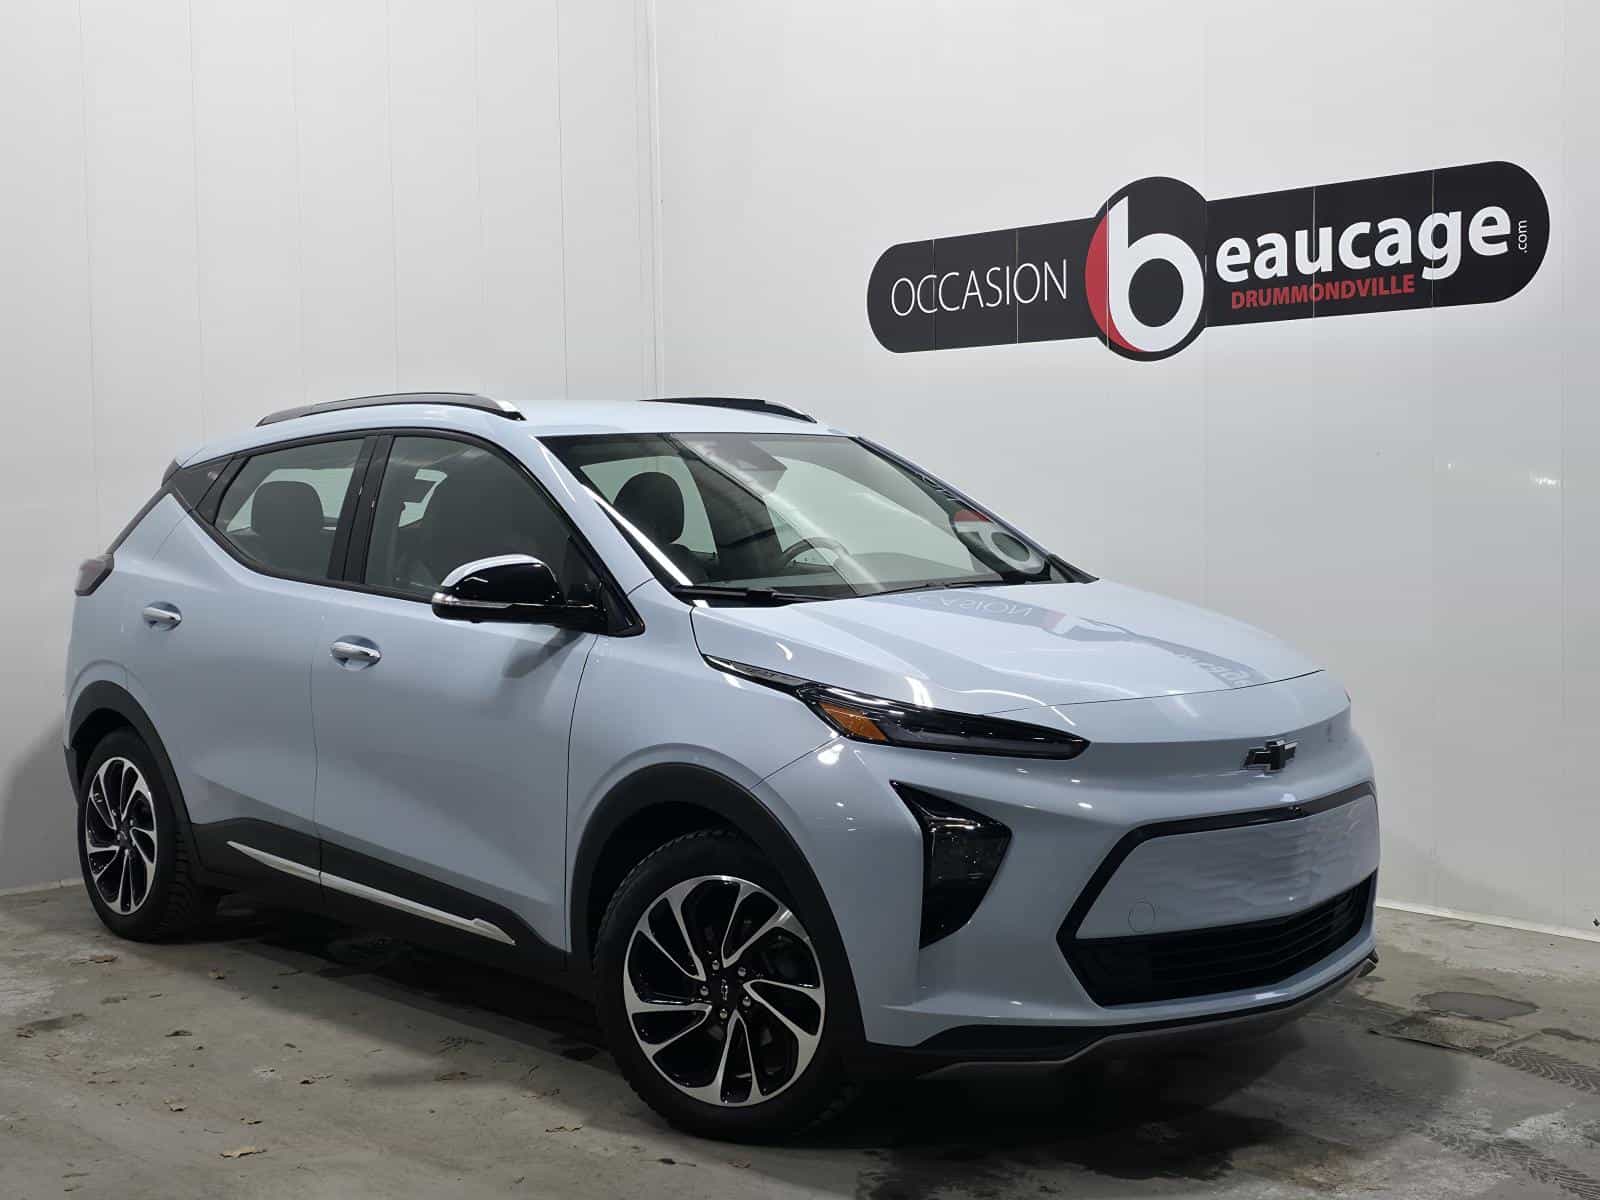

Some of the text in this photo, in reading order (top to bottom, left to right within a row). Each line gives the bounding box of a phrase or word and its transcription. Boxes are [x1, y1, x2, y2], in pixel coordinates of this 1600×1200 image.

[1517, 219, 1529, 254] .com
[891, 259, 1067, 316] OCCASION
[1231, 274, 1416, 310] DRUMMONDVILLE
